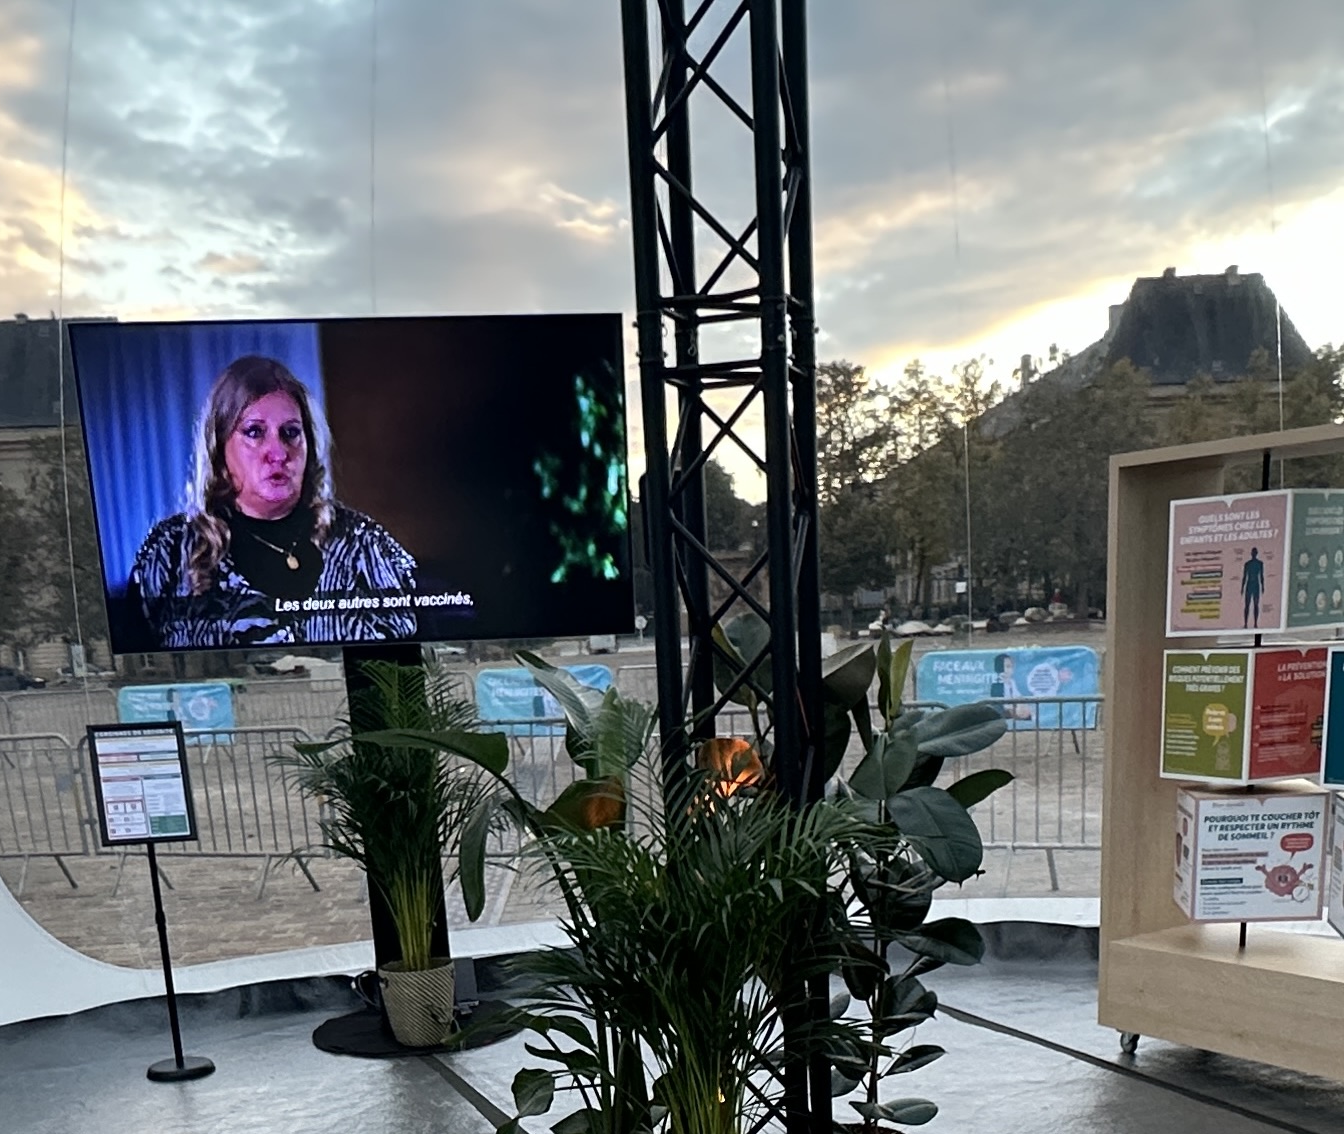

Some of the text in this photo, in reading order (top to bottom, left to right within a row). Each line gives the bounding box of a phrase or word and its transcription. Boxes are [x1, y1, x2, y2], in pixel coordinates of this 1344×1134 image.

[1198, 510, 1260, 524] QUELS SONT LES
[1188, 520, 1270, 534] SYMPTÔMES CHEZ LES
[1180, 535, 1213, 546] ENFANTS
[1214, 534, 1224, 542] ET
[1224, 532, 1237, 542] LES
[1239, 530, 1272, 540] ADULTES
[274, 591, 474, 612] Les deux autres sont vaccinés,
[1278, 664, 1286, 672] LA
[1204, 814, 1248, 823] POURQUOI
[1261, 812, 1302, 821] COUCHER
[1304, 810, 1320, 820] TÔT
[1219, 824, 1264, 832] RESPECTER
[1267, 822, 1280, 830] UN
[1280, 822, 1314, 830] RYTHME
[1230, 832, 1268, 840] SOMMEIL
